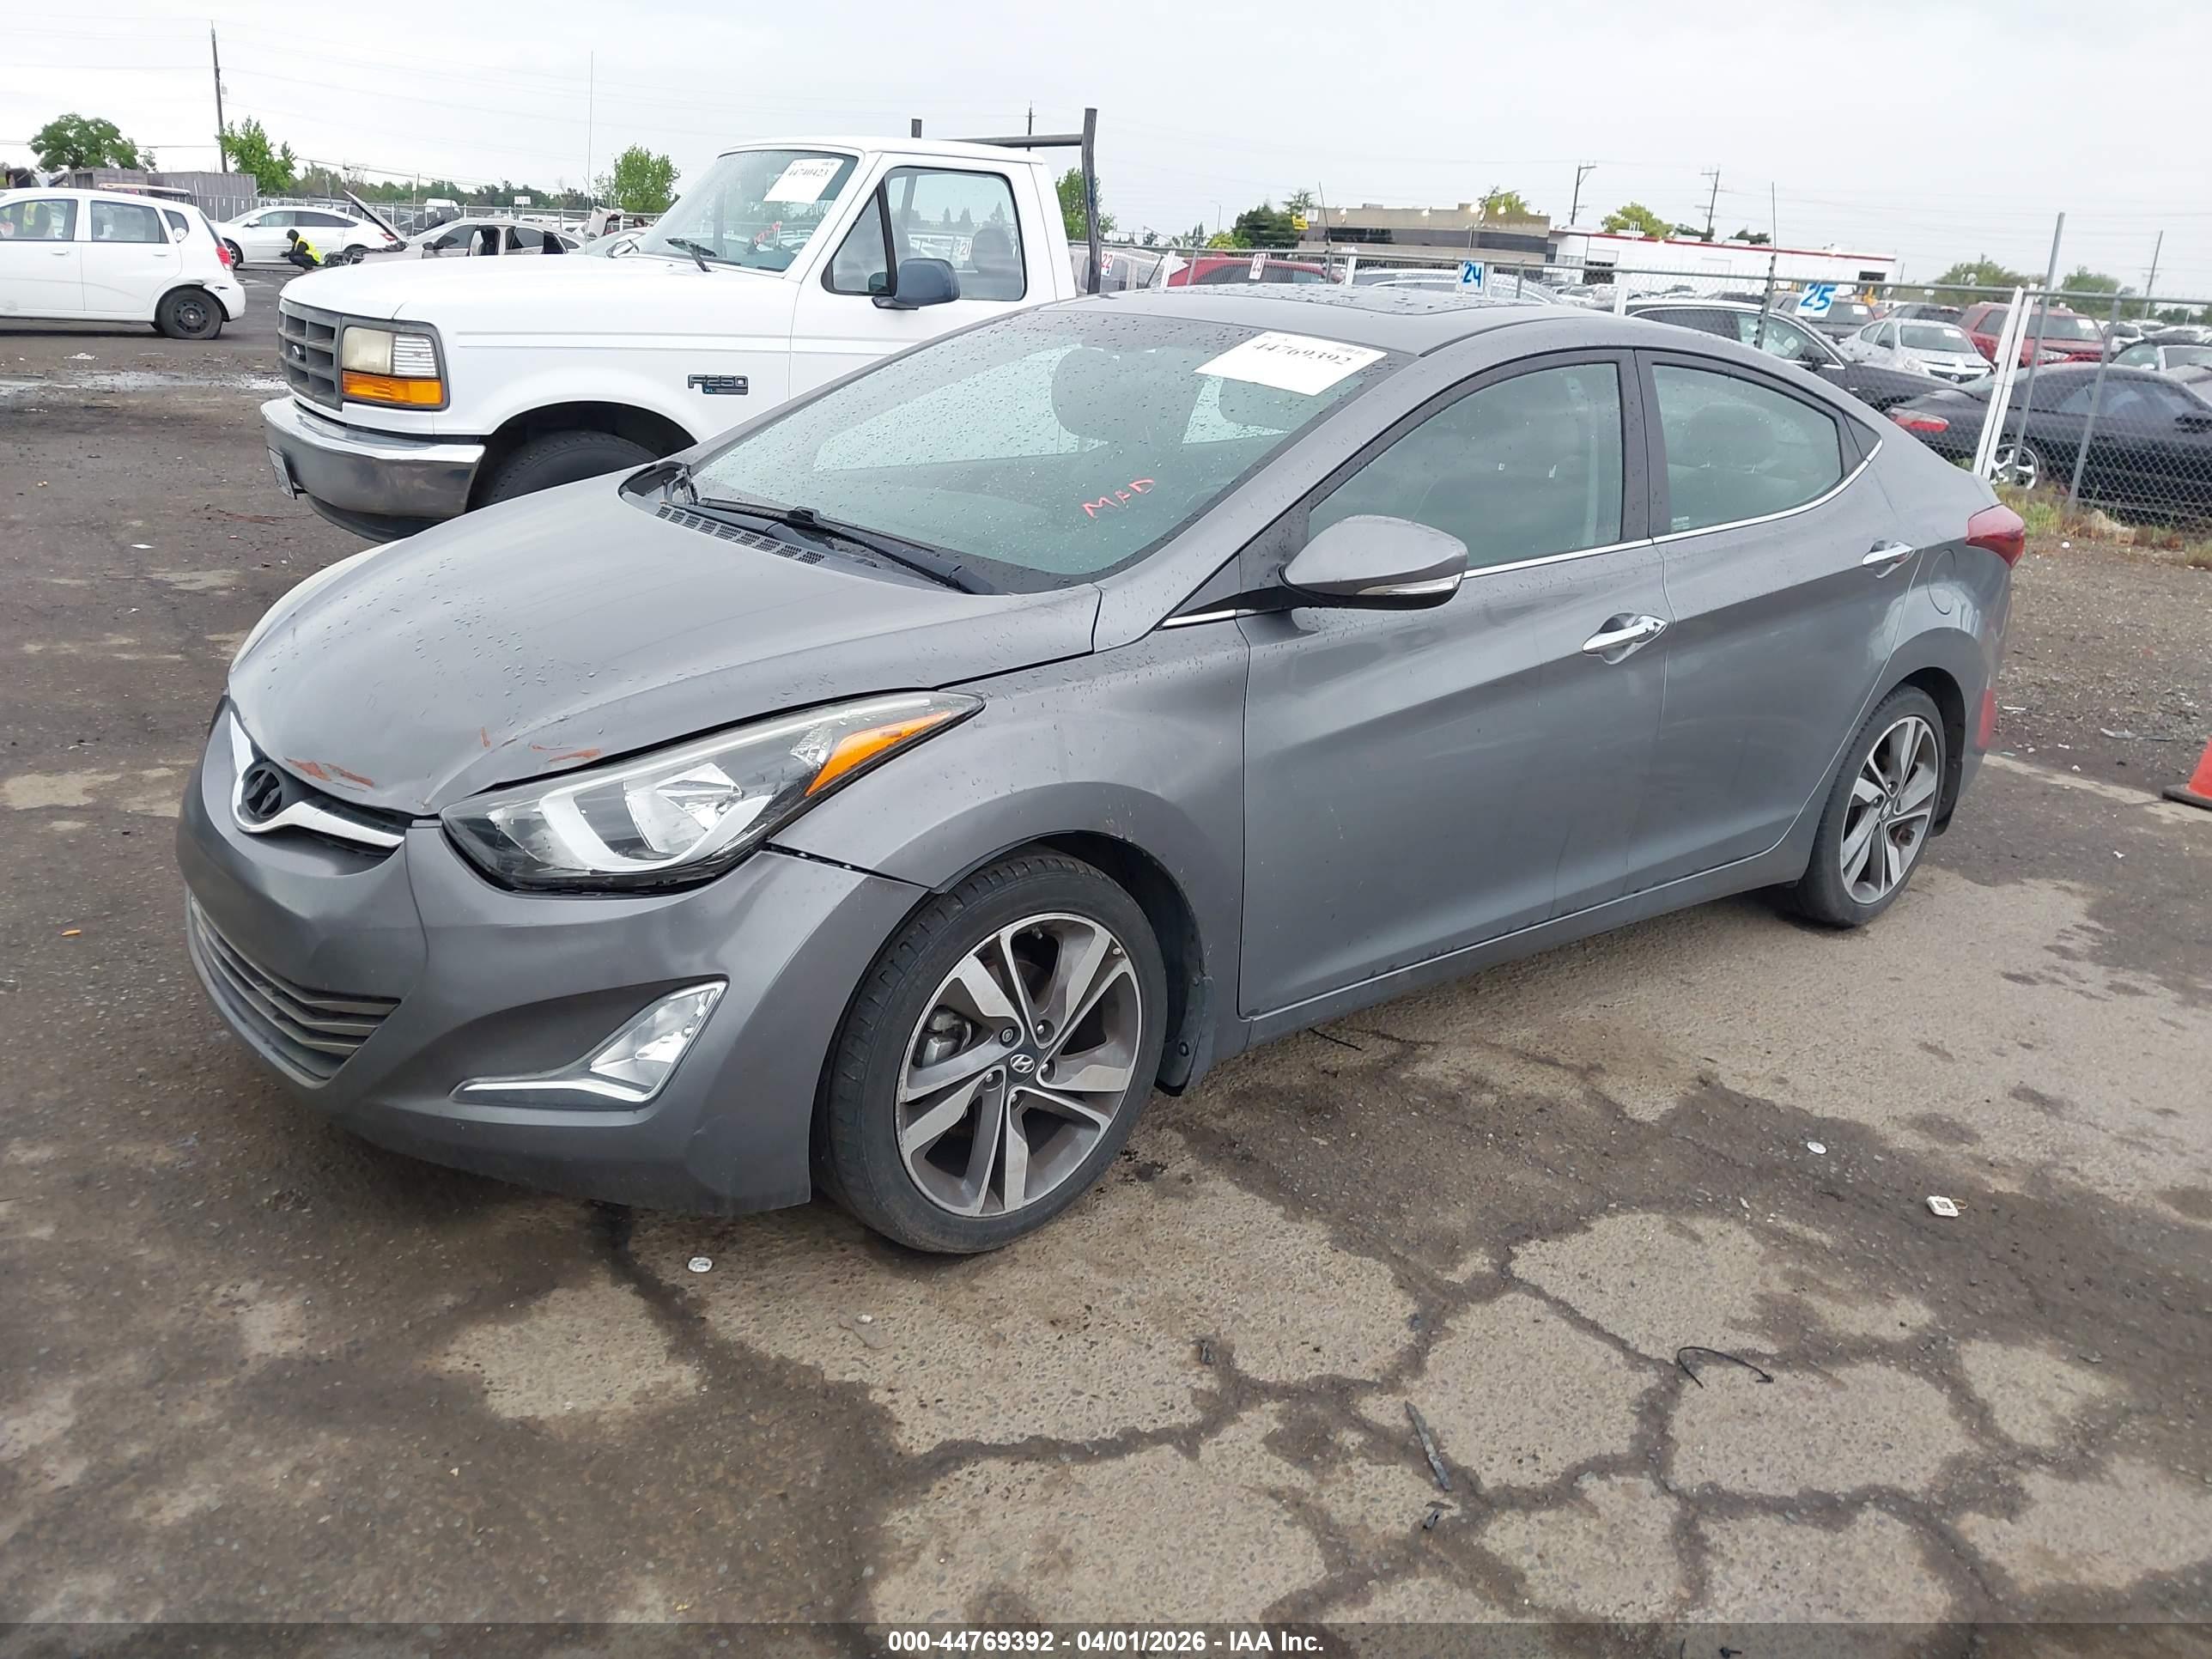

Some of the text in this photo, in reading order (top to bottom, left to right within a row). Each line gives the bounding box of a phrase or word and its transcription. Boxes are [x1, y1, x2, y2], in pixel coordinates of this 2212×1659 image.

[1100, 252, 1113, 269] 22
[1252, 254, 1265, 272] 23
[1462, 261, 1482, 289] 24
[1801, 283, 1835, 310] 25
[1253, 343, 1352, 365] 44769392
